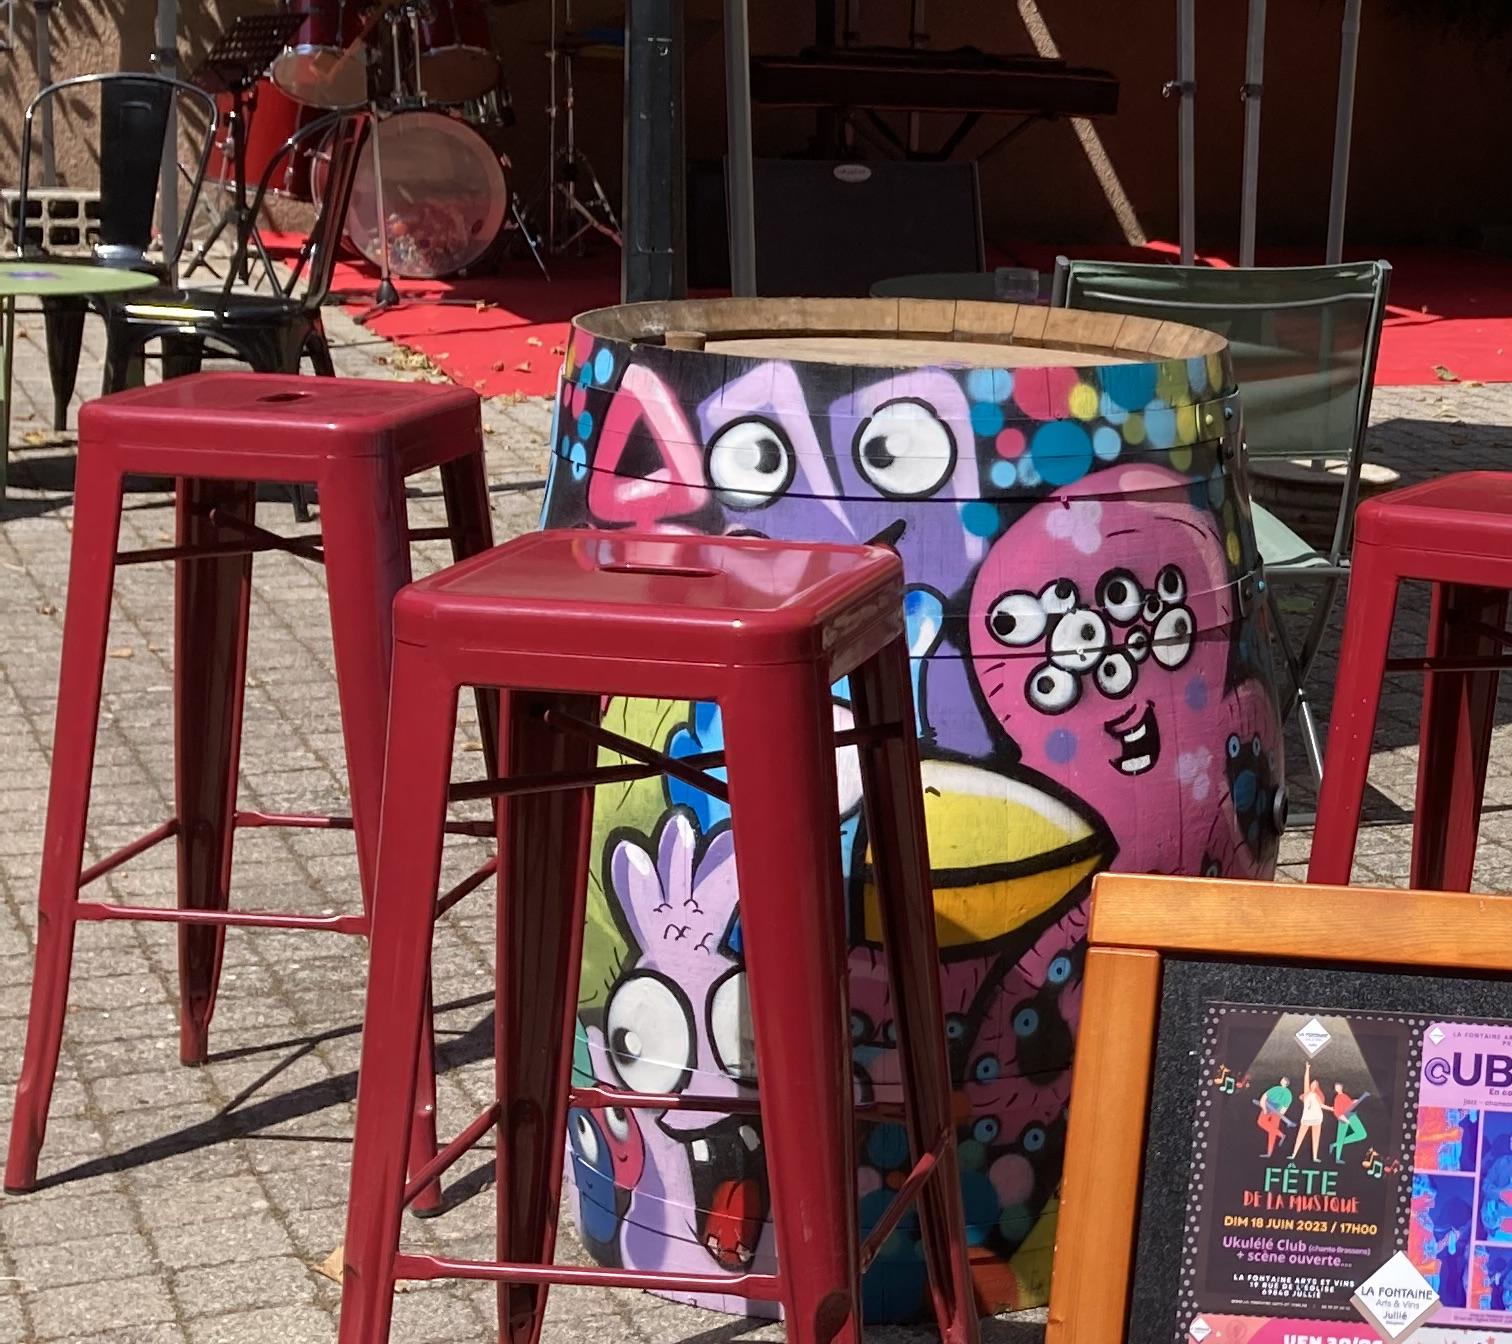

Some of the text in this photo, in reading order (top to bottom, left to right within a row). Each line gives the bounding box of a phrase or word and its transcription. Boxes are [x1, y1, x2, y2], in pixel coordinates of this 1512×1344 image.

[1264, 1163, 1338, 1196] FÊTE
[1243, 1190, 1360, 1213] DE LA MUSIQUE
[1224, 1216, 1248, 1227] DIM
[1251, 1217, 1263, 1227] 18
[1266, 1219, 1294, 1230] JUIN
[1296, 1220, 1327, 1232] 2023
[1340, 1223, 1377, 1235] 17H00
[1223, 1236, 1307, 1252] Ukulélé Club
[1247, 1250, 1286, 1263] scène
[1247, 1274, 1291, 1284] FONTAINE
[1361, 1286, 1433, 1301] LA FONTAINE
[1376, 1299, 1391, 1307] Arts
[1394, 1300, 1400, 1308] &
[1383, 1311, 1407, 1321] Jullié
